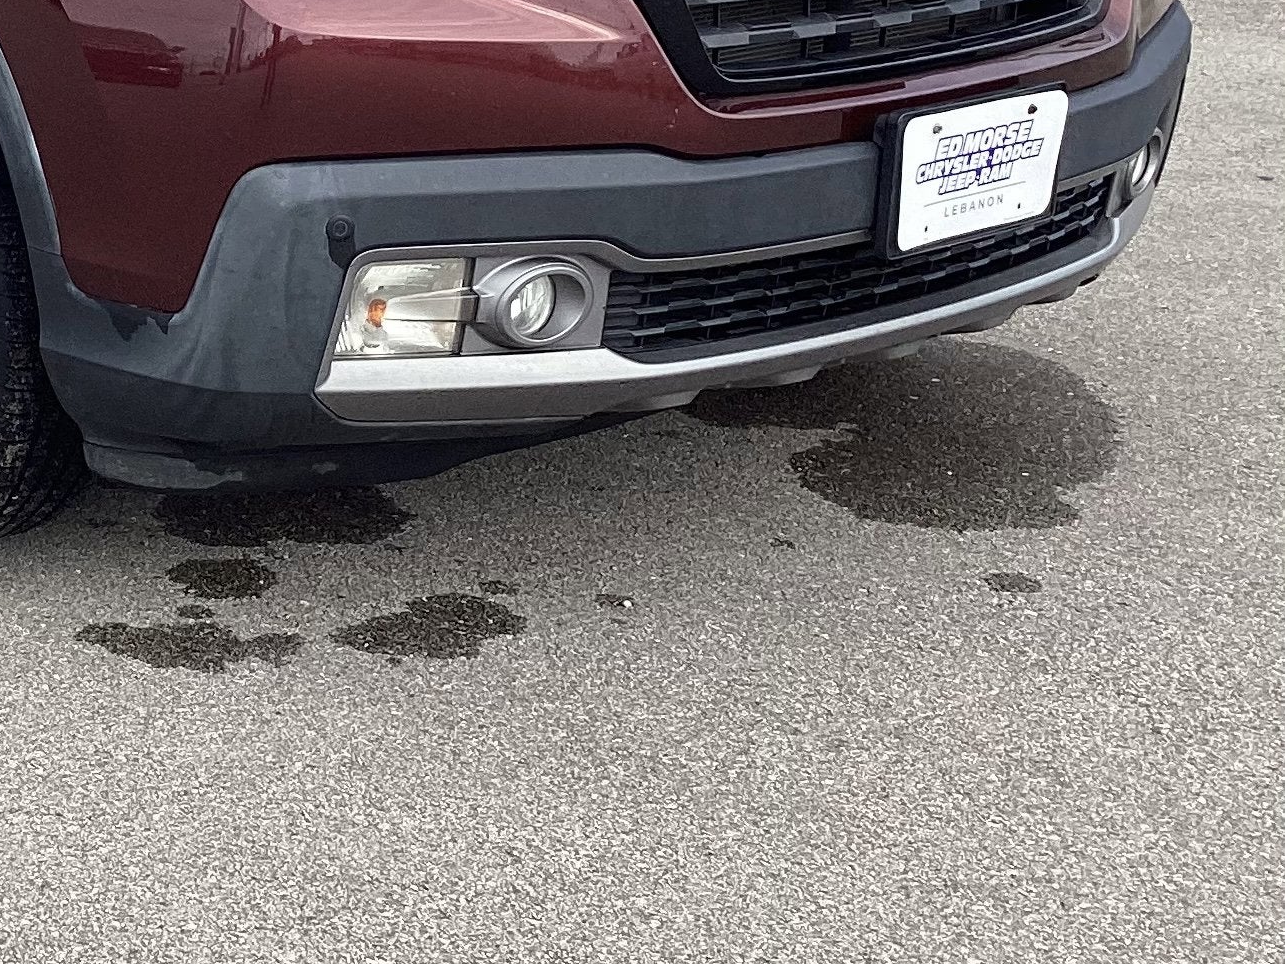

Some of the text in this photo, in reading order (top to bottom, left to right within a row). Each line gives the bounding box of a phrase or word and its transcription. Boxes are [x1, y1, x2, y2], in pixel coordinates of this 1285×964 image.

[935, 119, 1034, 161] ED MORSE
[944, 194, 1004, 217] LEBANON
